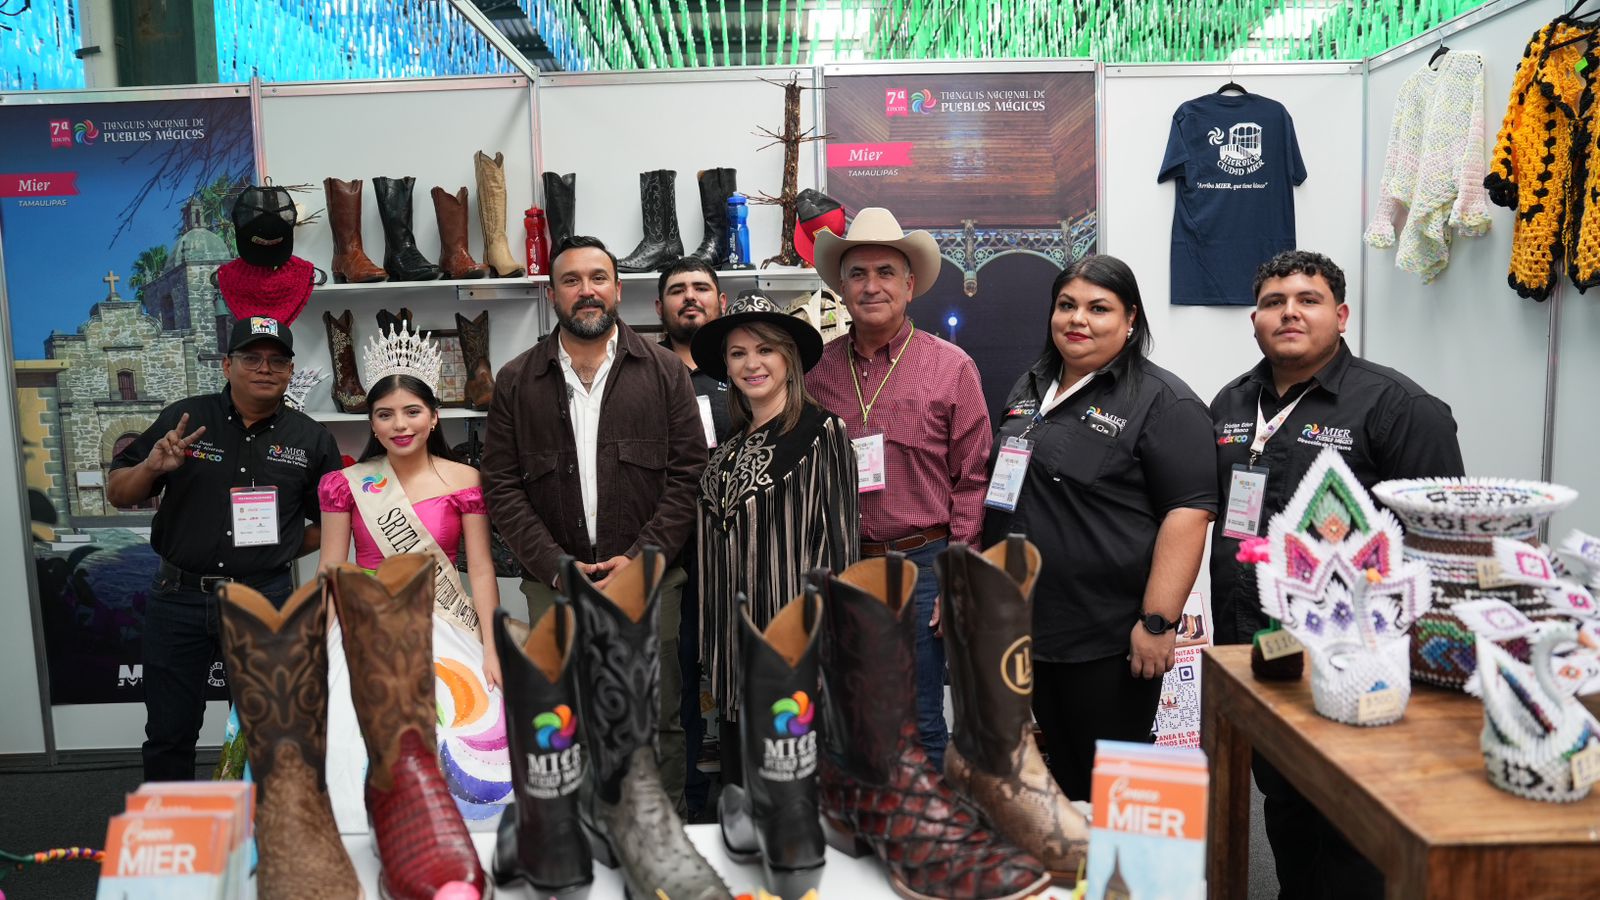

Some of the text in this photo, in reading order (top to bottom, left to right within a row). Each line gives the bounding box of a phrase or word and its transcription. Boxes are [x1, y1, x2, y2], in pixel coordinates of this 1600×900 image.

[848, 148, 883, 161] Mier
[848, 169, 899, 177] TAMAULIPAS
[18, 179, 50, 192] Mier
[1108, 801, 1186, 840] MIER
[118, 844, 197, 876] MIER
